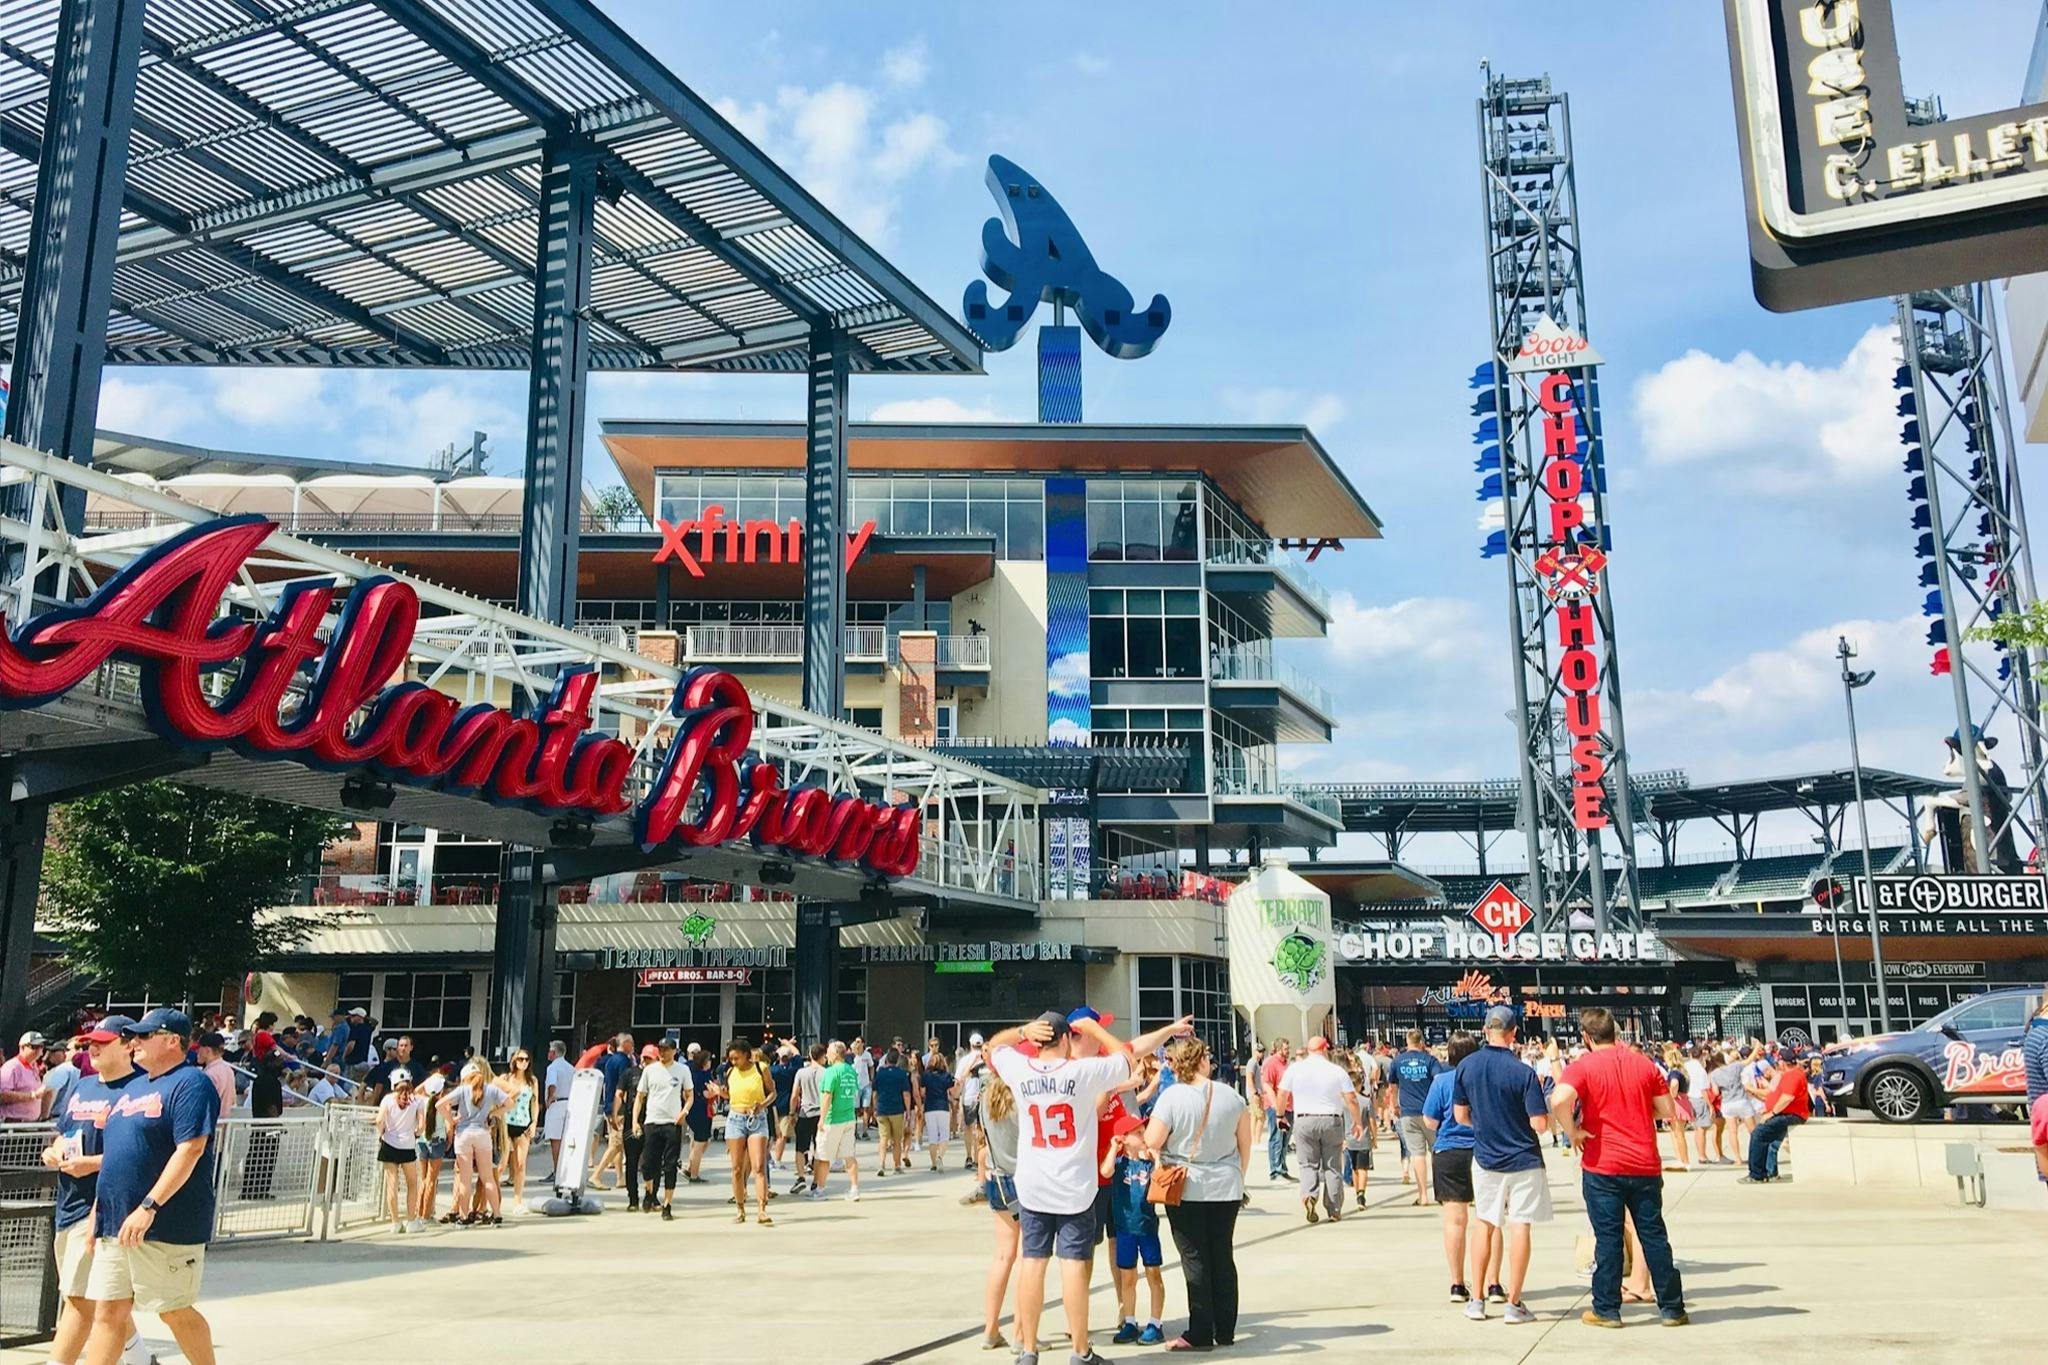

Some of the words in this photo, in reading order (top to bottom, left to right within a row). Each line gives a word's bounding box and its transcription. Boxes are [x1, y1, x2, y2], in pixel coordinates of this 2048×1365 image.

[1520, 332, 1589, 357] Coors
[1533, 352, 1577, 367] LIGHT
[1540, 371, 1584, 542] CHOP
[652, 504, 877, 577] xfiniy
[0, 513, 640, 816] Atlanta
[1557, 604, 1608, 830] HOUSE
[1947, 882, 2041, 908] BURGER
[1483, 901, 1523, 928] CH
[1900, 919, 1947, 933] TIME
[1955, 919, 1991, 933] ALL
[1999, 919, 2035, 933] THE
[601, 946, 695, 970] TERRAPIN
[701, 943, 788, 968] TAPROOM
[938, 941, 986, 962] FRESH
[989, 940, 1035, 962] BREW
[1038, 940, 1073, 961] BAR
[1339, 932, 1434, 960] CHOP
[1446, 932, 1568, 960] HOUSE
[1571, 932, 1656, 960] GATE
[657, 971, 675, 980] FOX
[677, 971, 704, 980] BROS.
[706, 970, 743, 980] BAR-B-Q
[1905, 964, 1929, 975] OPEN
[1932, 963, 1976, 975] EVERYDAY
[1774, 997, 1807, 1007] BURGERS
[1819, 997, 1838, 1007] COLD
[1918, 997, 1939, 1006] FRIES
[1400, 1066, 1428, 1074] COSTA
[1020, 1075, 1057, 1098] ACUÑA
[1059, 1079, 1077, 1097] JR.
[1028, 1103, 1077, 1149] 13
